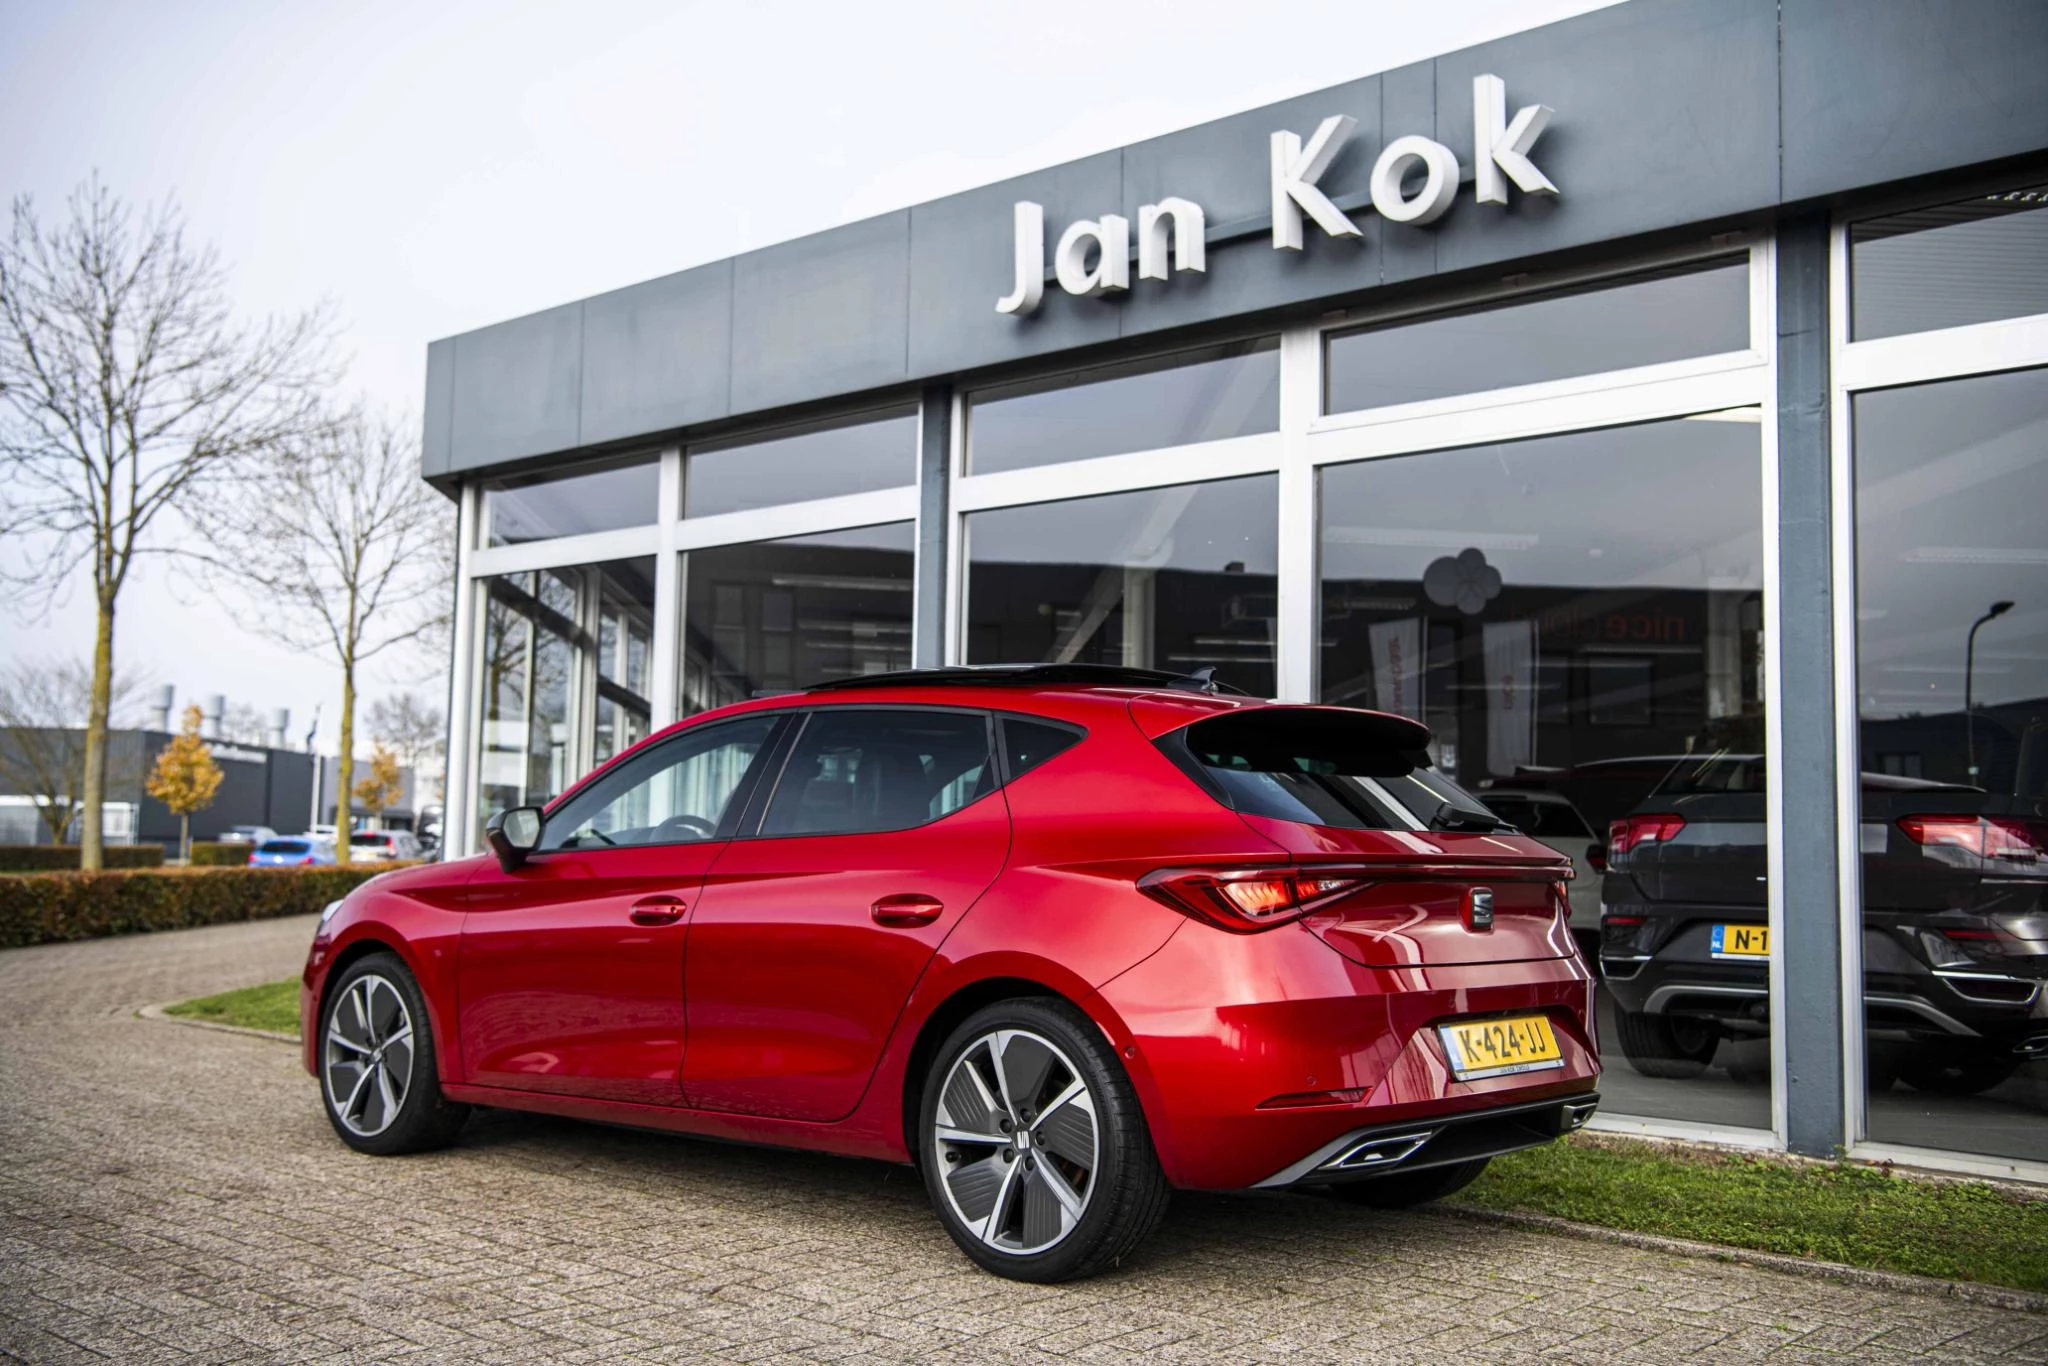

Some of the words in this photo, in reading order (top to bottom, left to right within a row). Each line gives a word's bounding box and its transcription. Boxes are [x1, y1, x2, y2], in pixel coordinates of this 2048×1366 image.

[995, 197, 1206, 315] Jan
[1270, 73, 1559, 252] Kok
[1458, 1022, 1546, 1063] K-424-JJ
